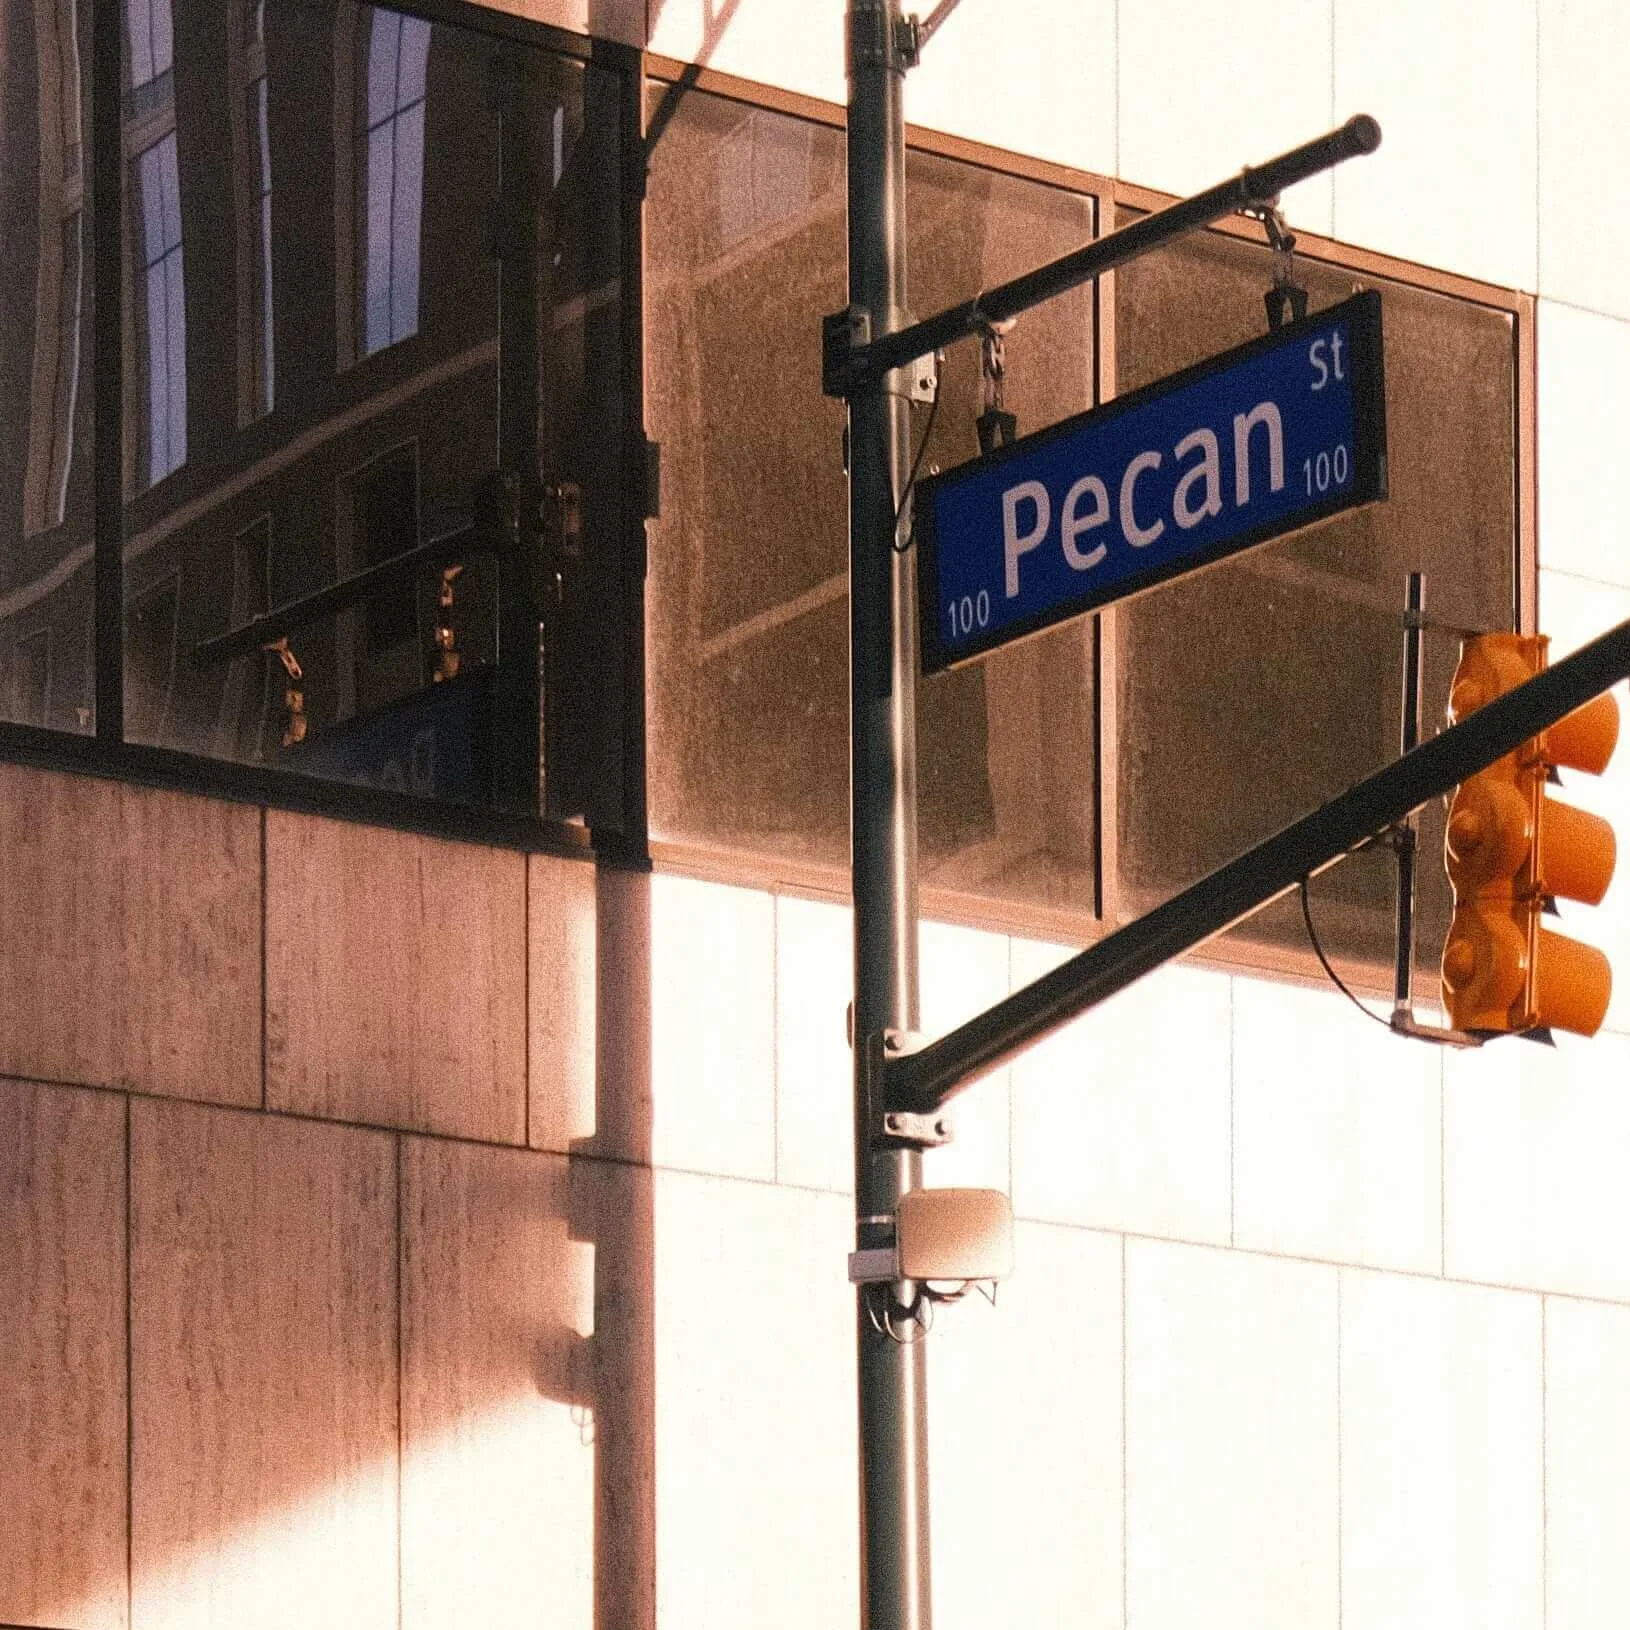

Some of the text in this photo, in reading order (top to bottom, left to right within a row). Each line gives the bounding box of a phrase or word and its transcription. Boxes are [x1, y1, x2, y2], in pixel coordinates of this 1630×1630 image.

[1308, 331, 1344, 391] St
[1303, 445, 1348, 496] 100
[1002, 401, 1285, 598] Pecan
[948, 590, 990, 638] 100
